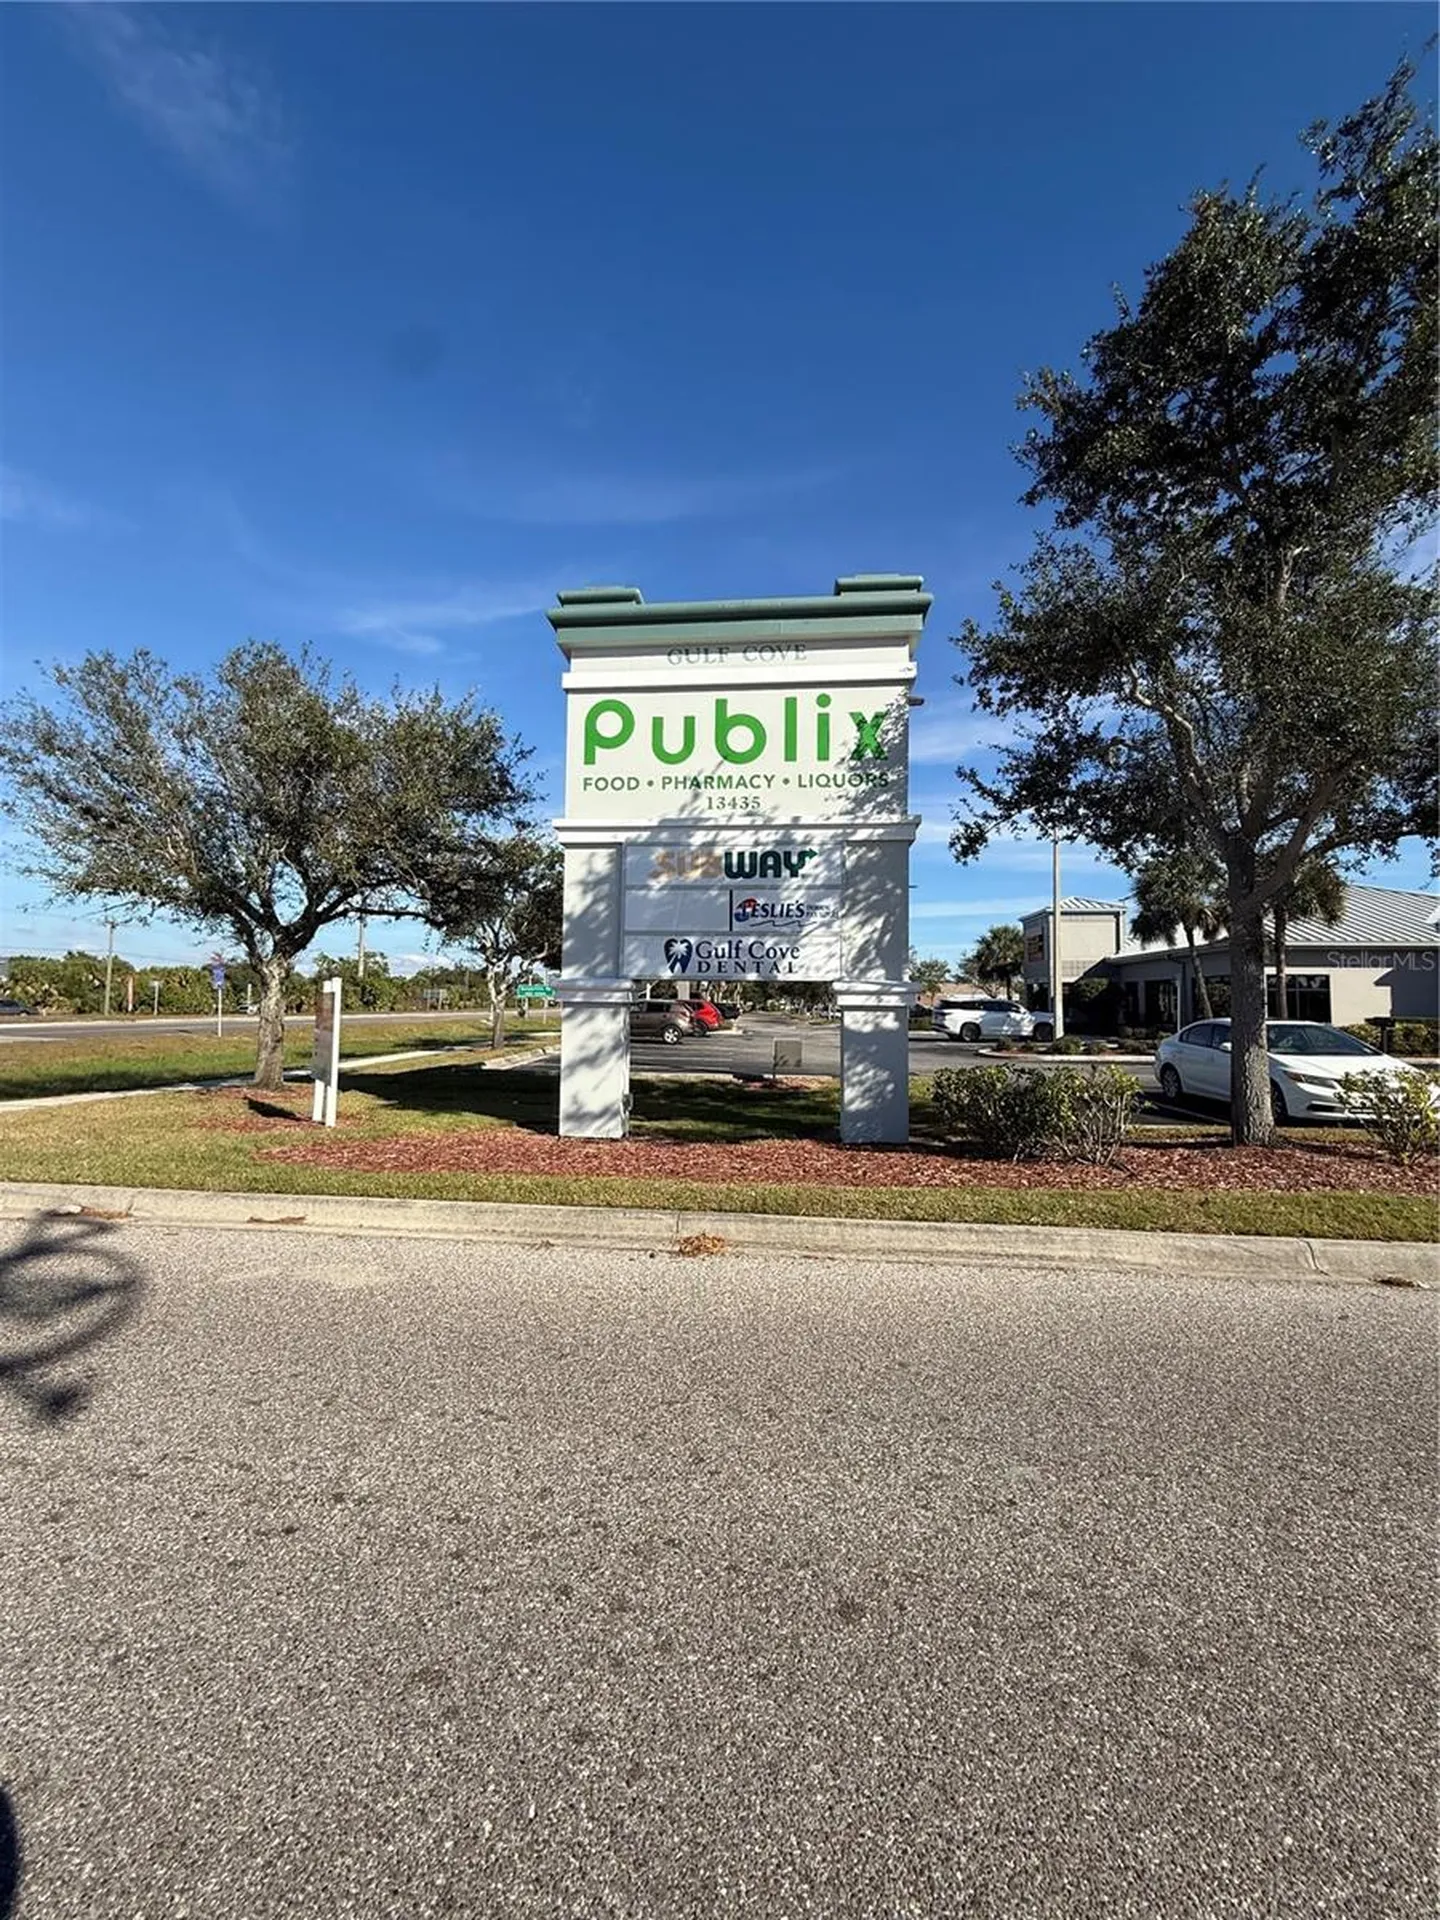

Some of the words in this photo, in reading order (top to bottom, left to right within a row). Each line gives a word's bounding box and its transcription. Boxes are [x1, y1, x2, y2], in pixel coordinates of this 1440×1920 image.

[667, 646, 730, 665] GULF
[742, 643, 807, 662] COVE
[583, 693, 888, 765] Publix
[583, 776, 640, 791] FOOD
[661, 774, 775, 790] PHARMACY
[798, 773, 889, 788] LIQUORS
[706, 796, 761, 810] 13435
[695, 939, 742, 960] Gulf
[748, 940, 800, 960] Cove
[697, 961, 800, 974] DENTAL
